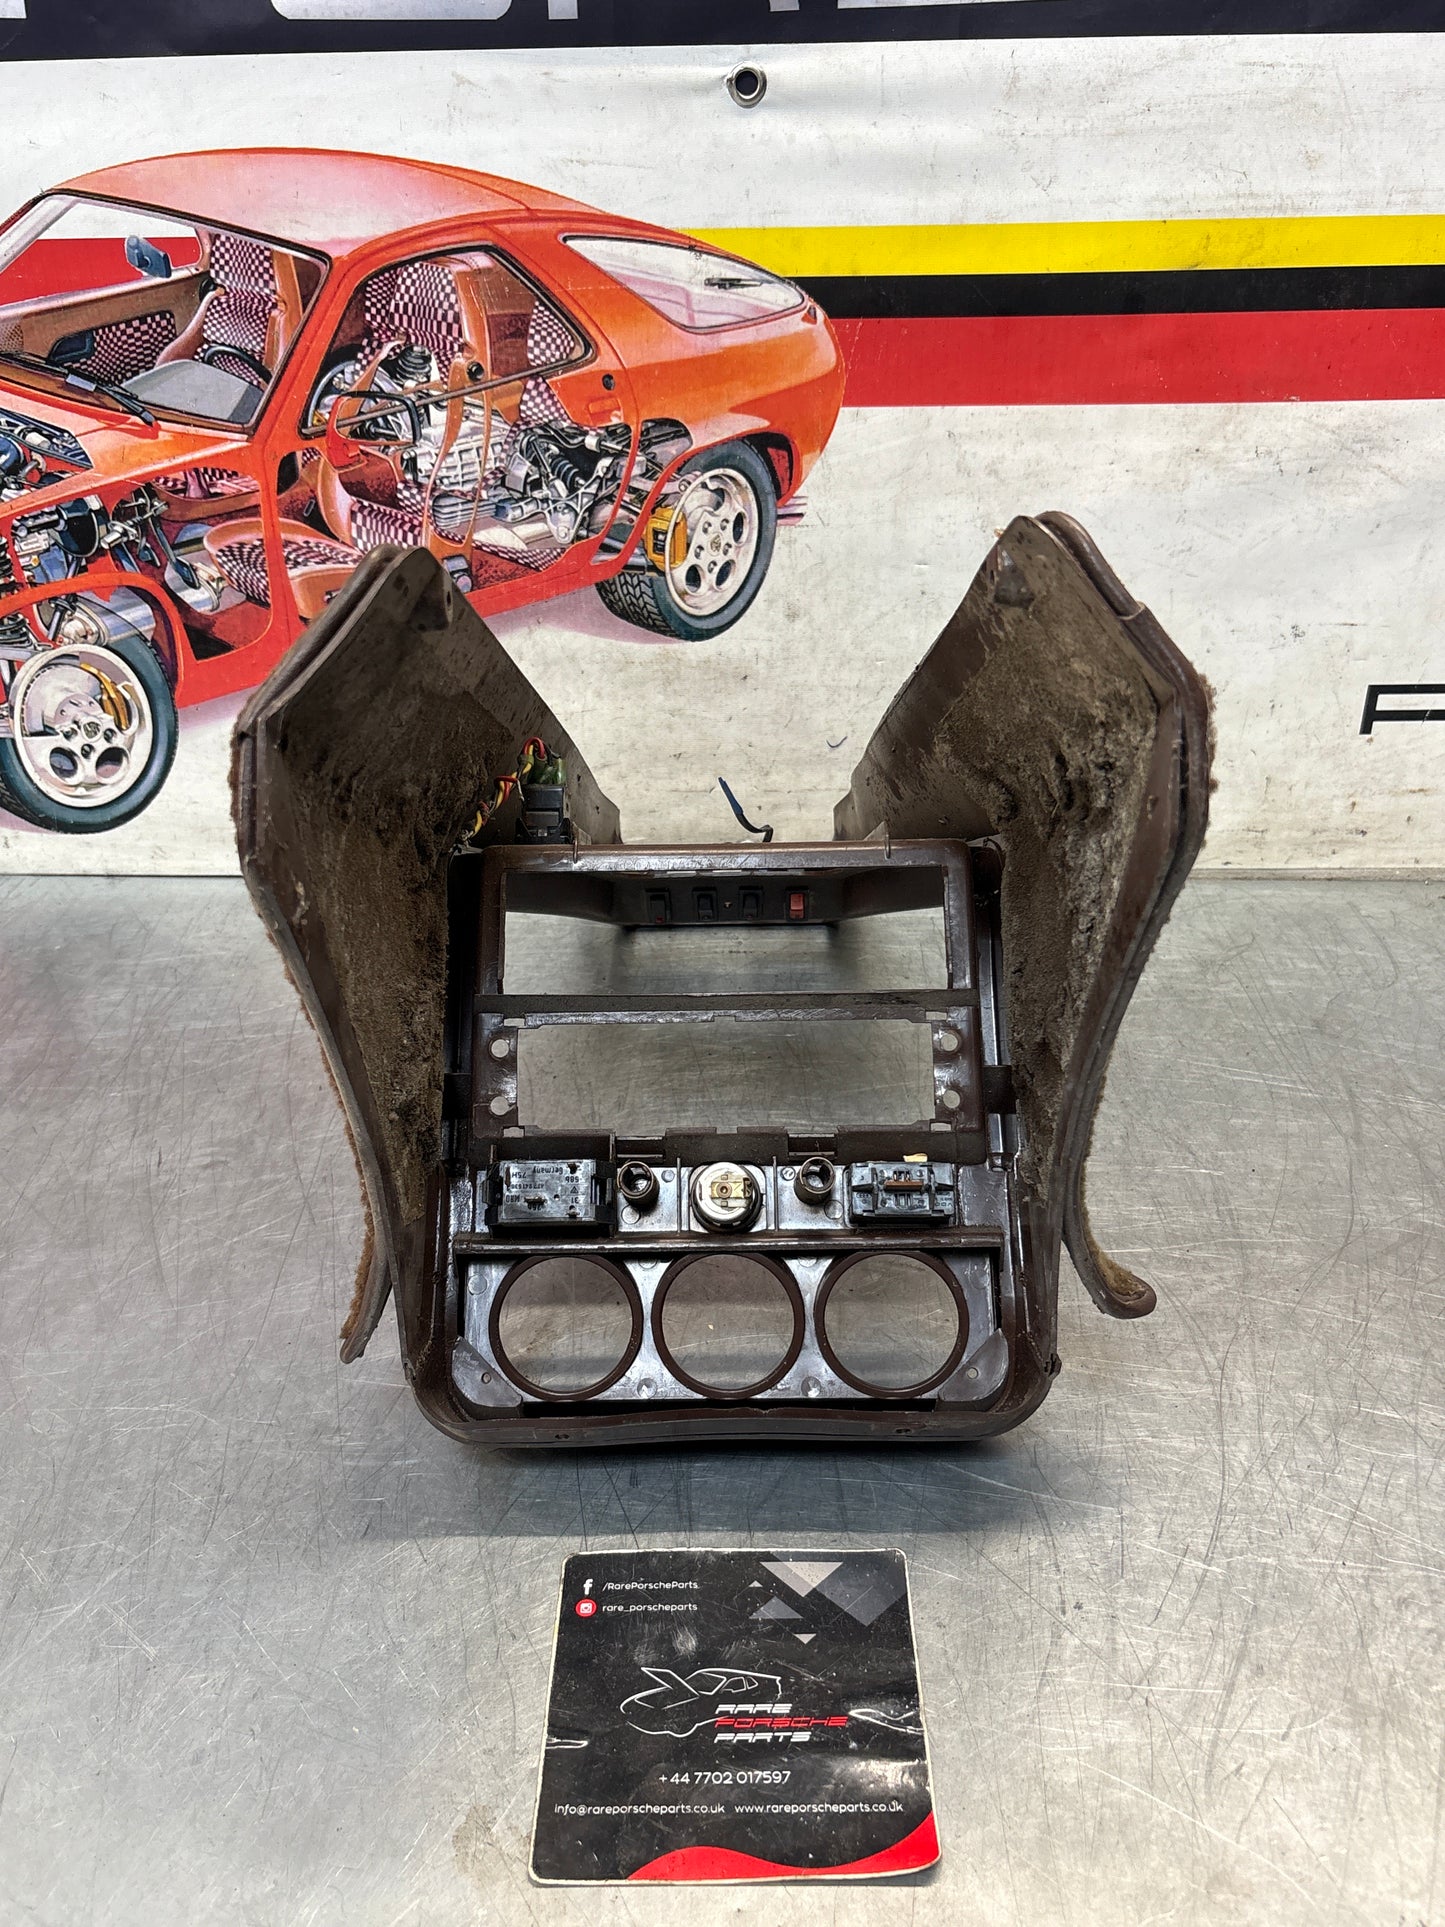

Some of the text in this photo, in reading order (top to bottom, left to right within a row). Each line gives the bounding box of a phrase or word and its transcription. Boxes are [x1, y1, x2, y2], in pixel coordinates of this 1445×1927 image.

[532, 1166, 564, 1175] Germany
[602, 1580, 698, 1592] /RarePorscheParts
[602, 1603, 698, 1612] rare_porscheparts
[715, 1703, 792, 1714] RARE
[715, 1716, 848, 1729] PORSCHE
[713, 1731, 812, 1743] PARTS
[694, 1771, 733, 1785] 7702
[737, 1771, 791, 1784] 017597
[554, 1801, 904, 1816] info@rareporscheparts.co.uk www.rareporscheparts.co.uk
